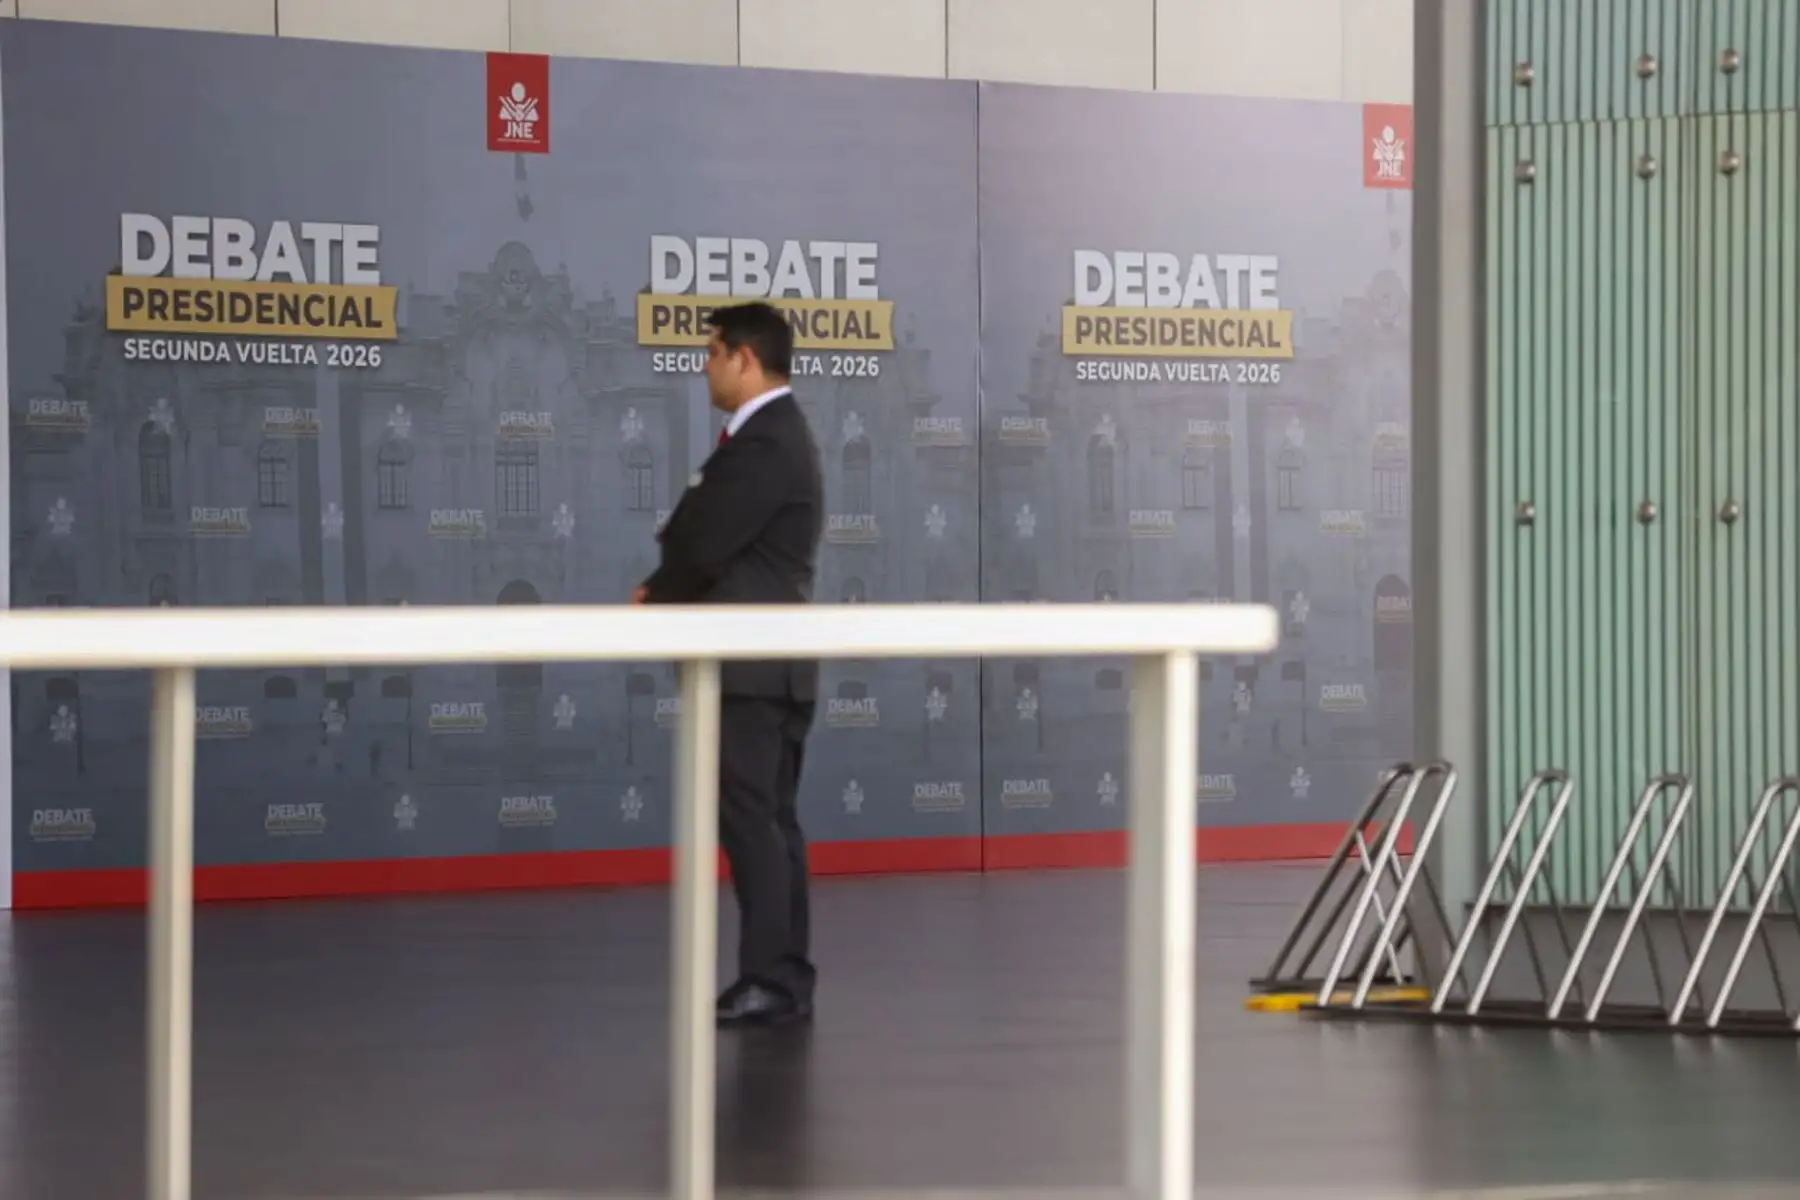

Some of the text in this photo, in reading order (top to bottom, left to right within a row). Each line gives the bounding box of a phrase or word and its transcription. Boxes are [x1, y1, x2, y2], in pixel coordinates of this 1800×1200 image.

[504, 121, 533, 138] JNE
[120, 213, 381, 286] DEBATE
[650, 235, 879, 301] DEBATE
[1073, 250, 1280, 311] DEBATE
[122, 287, 382, 328] PRESIDENCIAL
[653, 305, 881, 339] PRENCIAL
[1075, 315, 1281, 348] PRESIDENCIAL
[124, 338, 381, 367] SEGUNDA VUELTA 2026
[653, 352, 880, 377] SEGU LTA 2026
[1076, 361, 1281, 384] SEGUNDA VUELTA 2026
[30, 399, 89, 417] DEBATE
[191, 507, 248, 523] DEBATE
[431, 702, 484, 717] DEBATE
[828, 698, 877, 713] DEBATE
[914, 783, 962, 798] DEBATE
[1003, 780, 1050, 794] DEBATE
[33, 809, 92, 826] DEBATE
[268, 803, 324, 819] DEBATE
